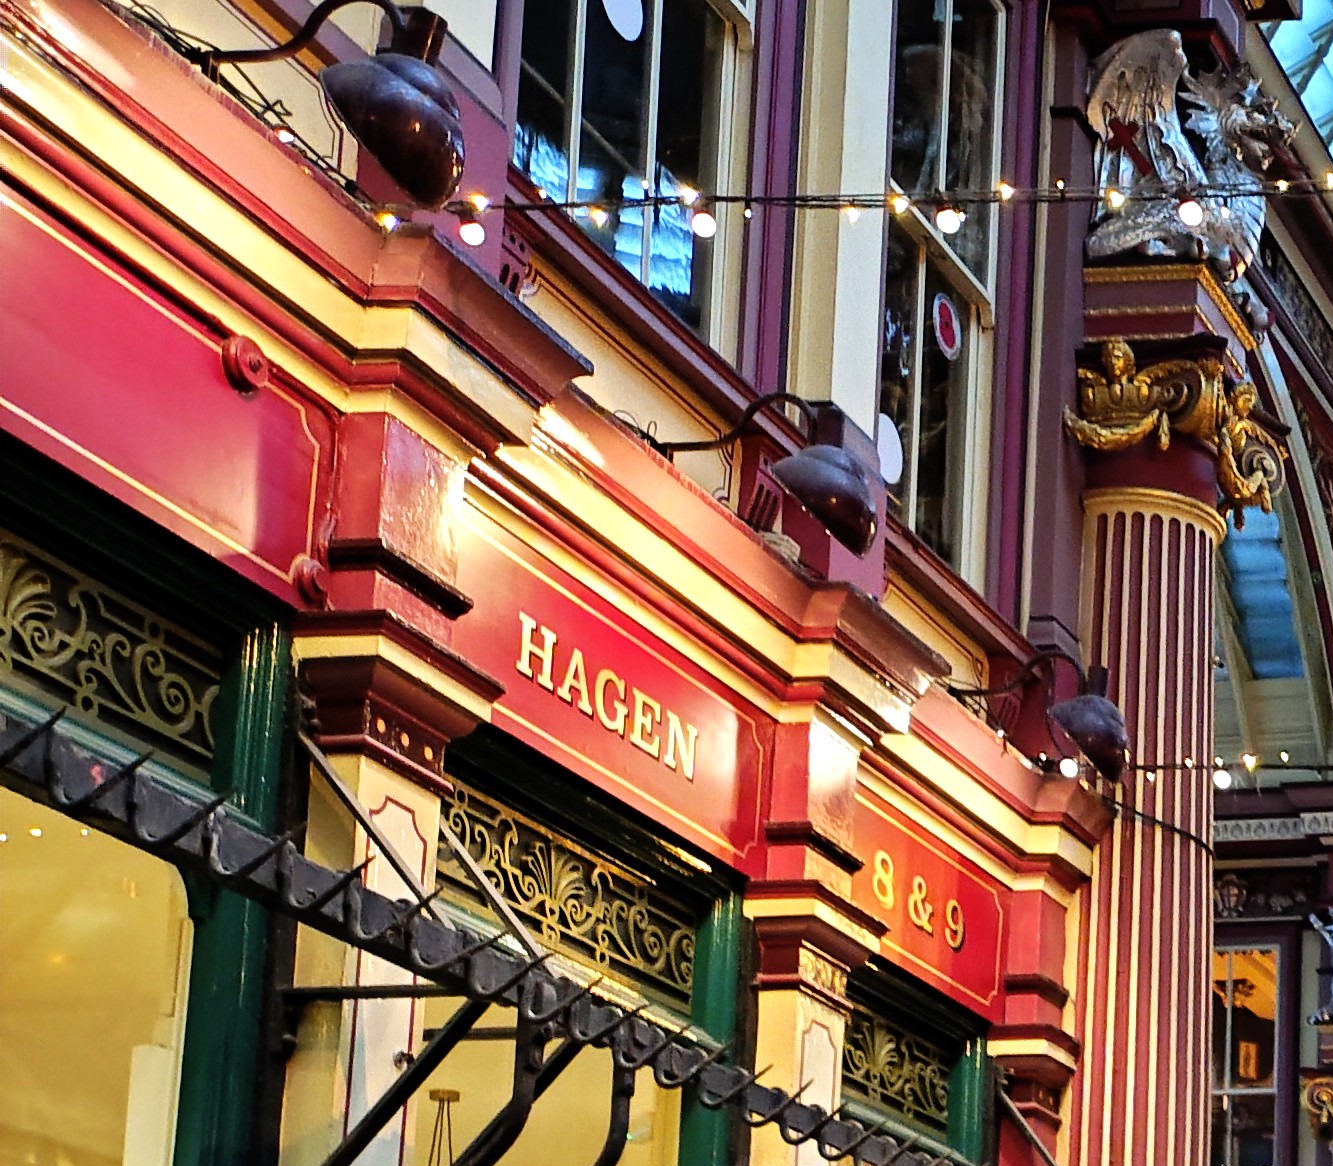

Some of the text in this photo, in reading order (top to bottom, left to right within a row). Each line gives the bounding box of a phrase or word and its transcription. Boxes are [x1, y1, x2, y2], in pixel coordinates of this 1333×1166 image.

[516, 611, 699, 783] HAGEN
[873, 850, 965, 953] 8 & 9
